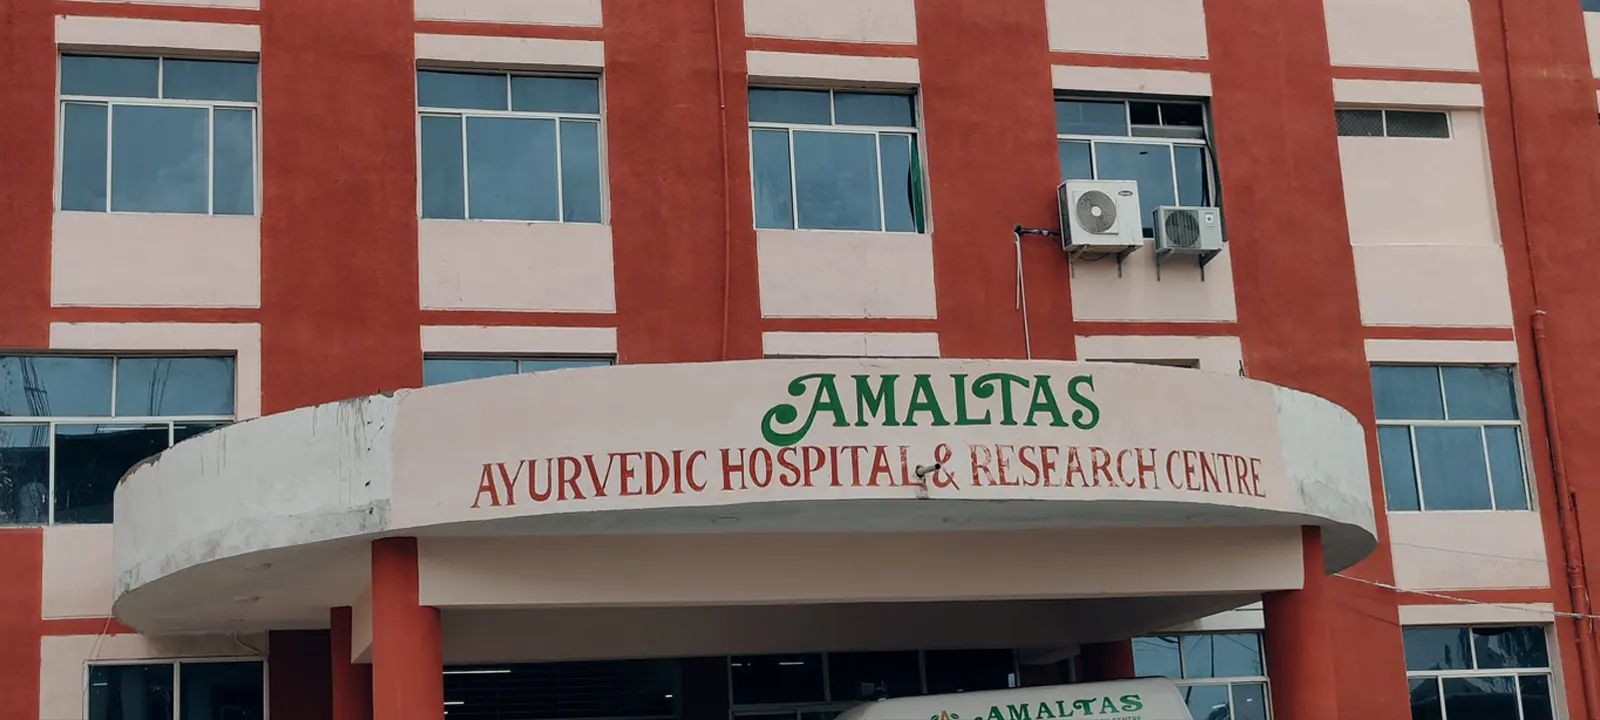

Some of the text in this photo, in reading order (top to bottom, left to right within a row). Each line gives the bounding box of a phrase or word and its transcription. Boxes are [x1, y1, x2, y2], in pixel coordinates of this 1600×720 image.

[762, 372, 1101, 447] AMALTAS
[471, 442, 1267, 509] AYURVEDIC HOSPITAL & RESEARCH CENTRE
[974, 693, 1144, 720] AMALTAS
